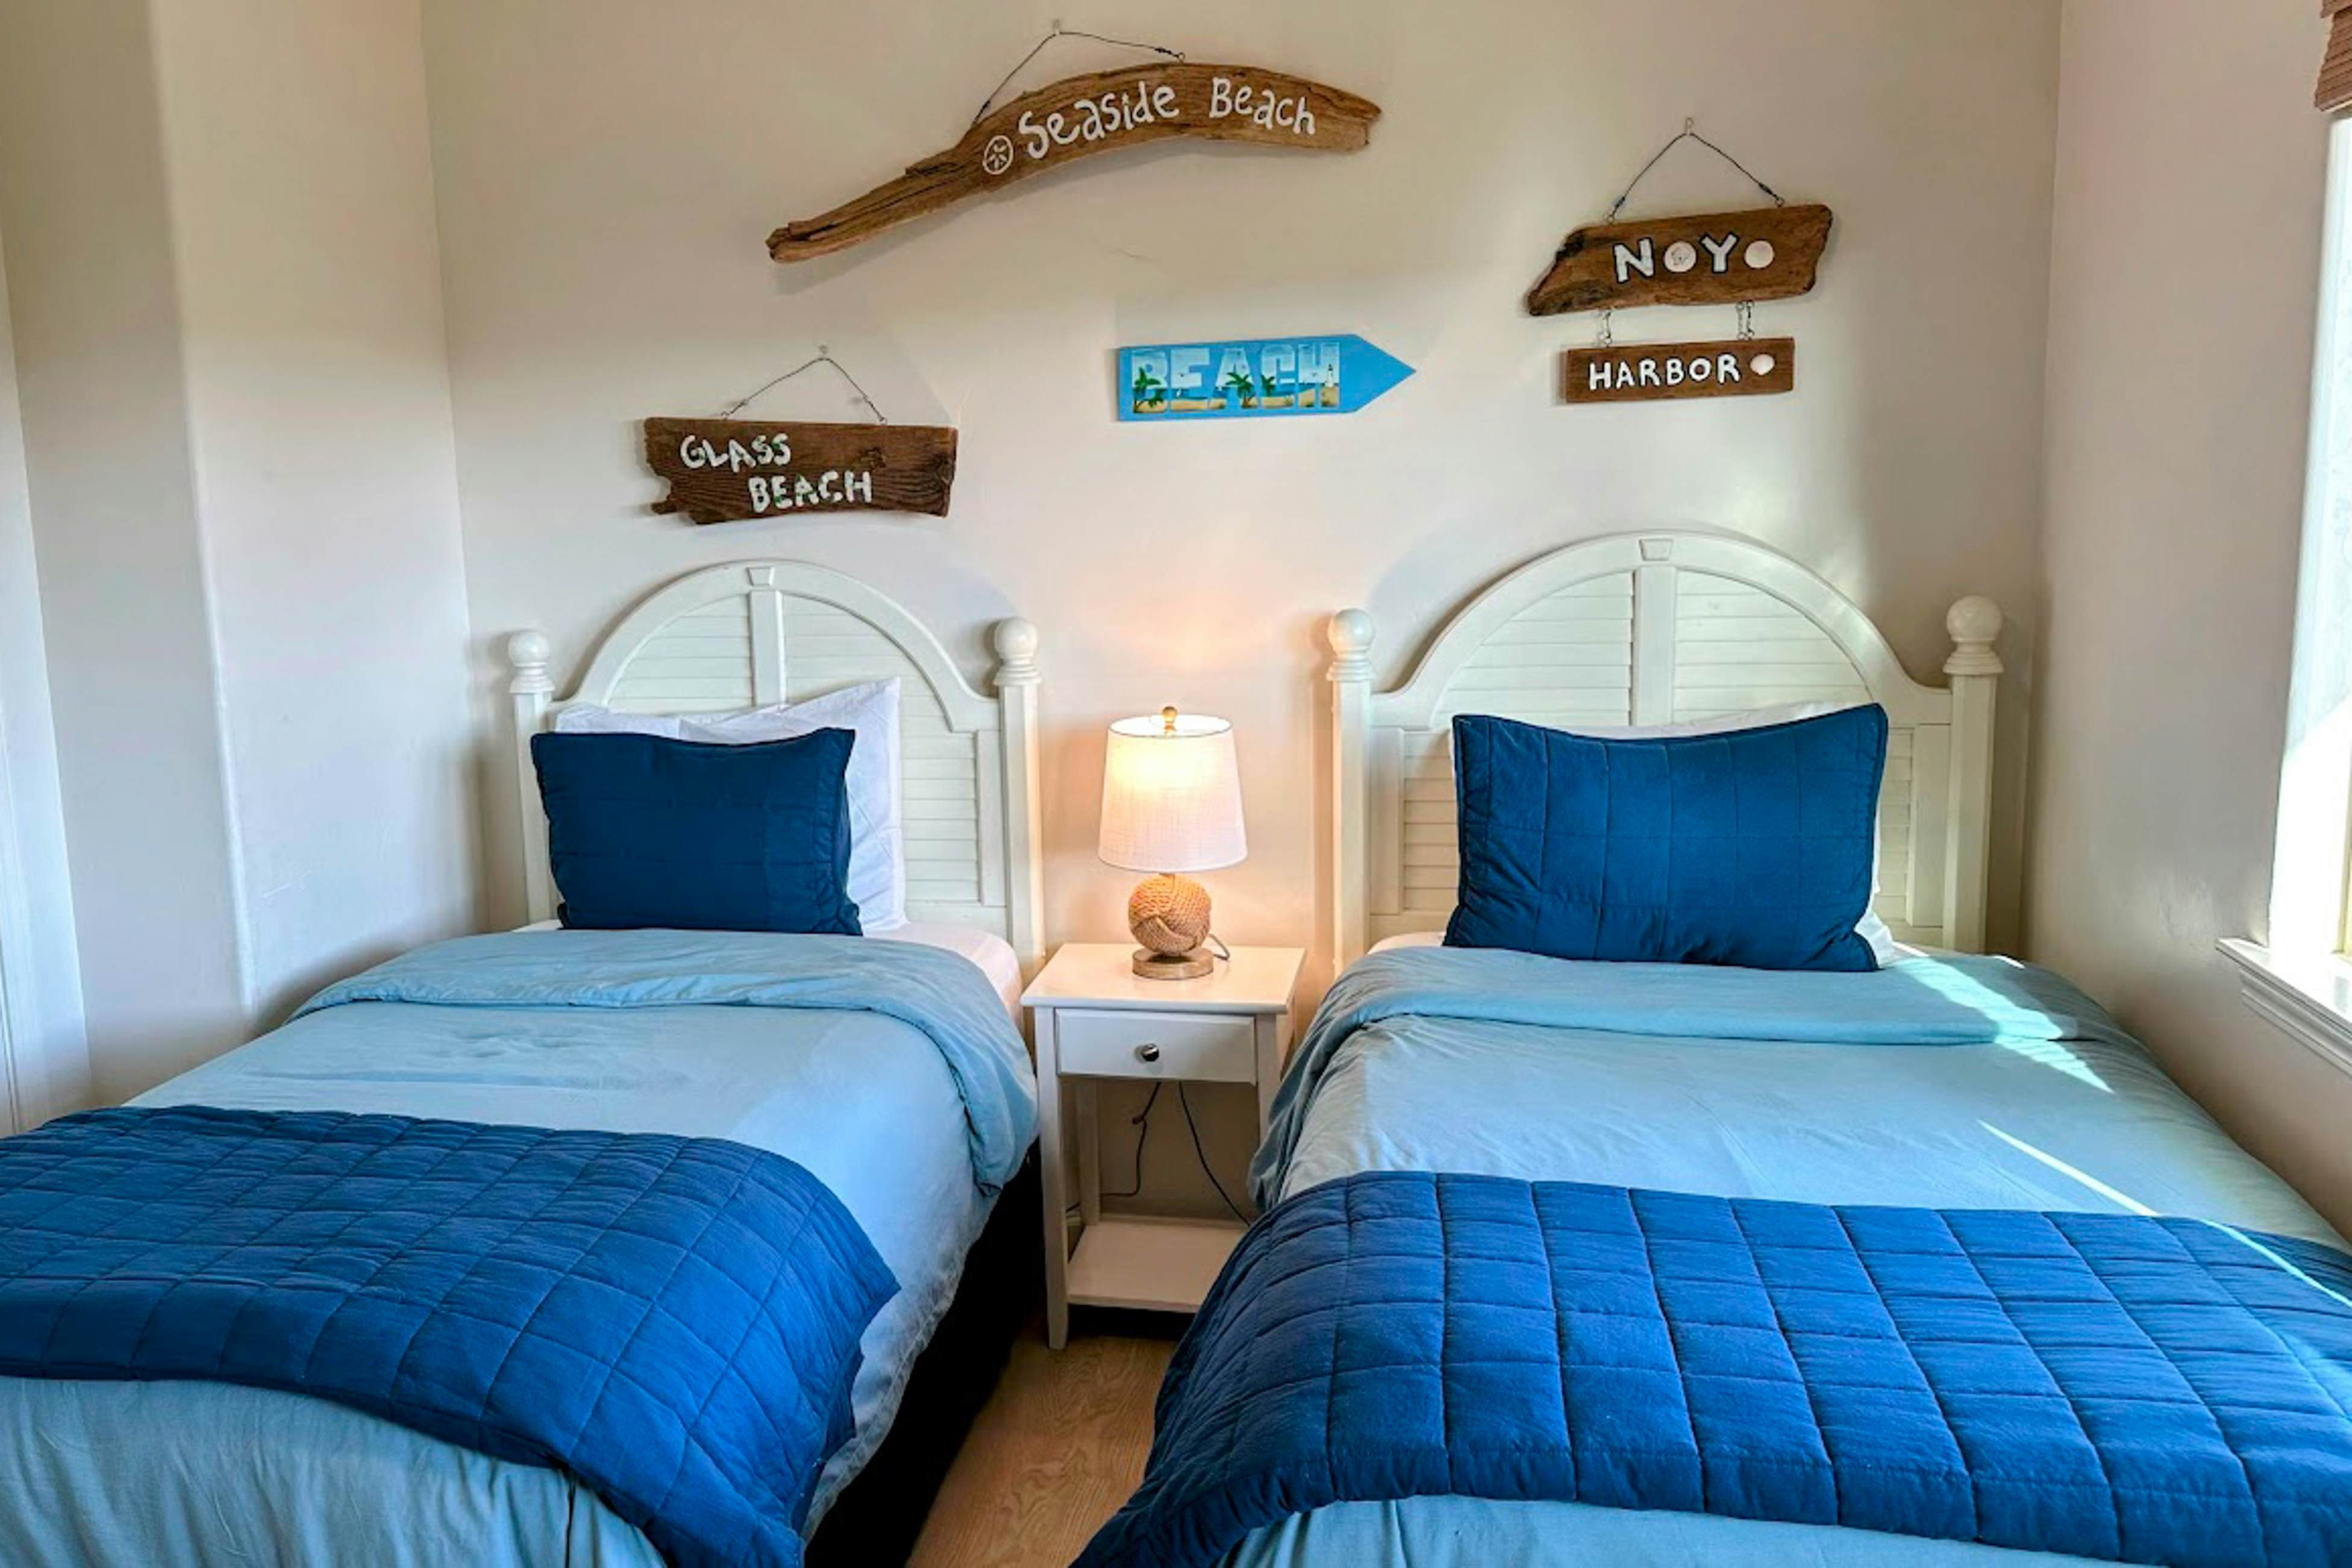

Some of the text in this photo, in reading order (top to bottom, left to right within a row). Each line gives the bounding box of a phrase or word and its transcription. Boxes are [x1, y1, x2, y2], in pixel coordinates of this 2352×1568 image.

[1019, 77, 1315, 159] Seaside Beach
[1132, 342, 1340, 413] BEACH
[1589, 353, 1741, 390] HARBOR
[680, 433, 791, 472] GLASS
[748, 470, 872, 513] BEACH
